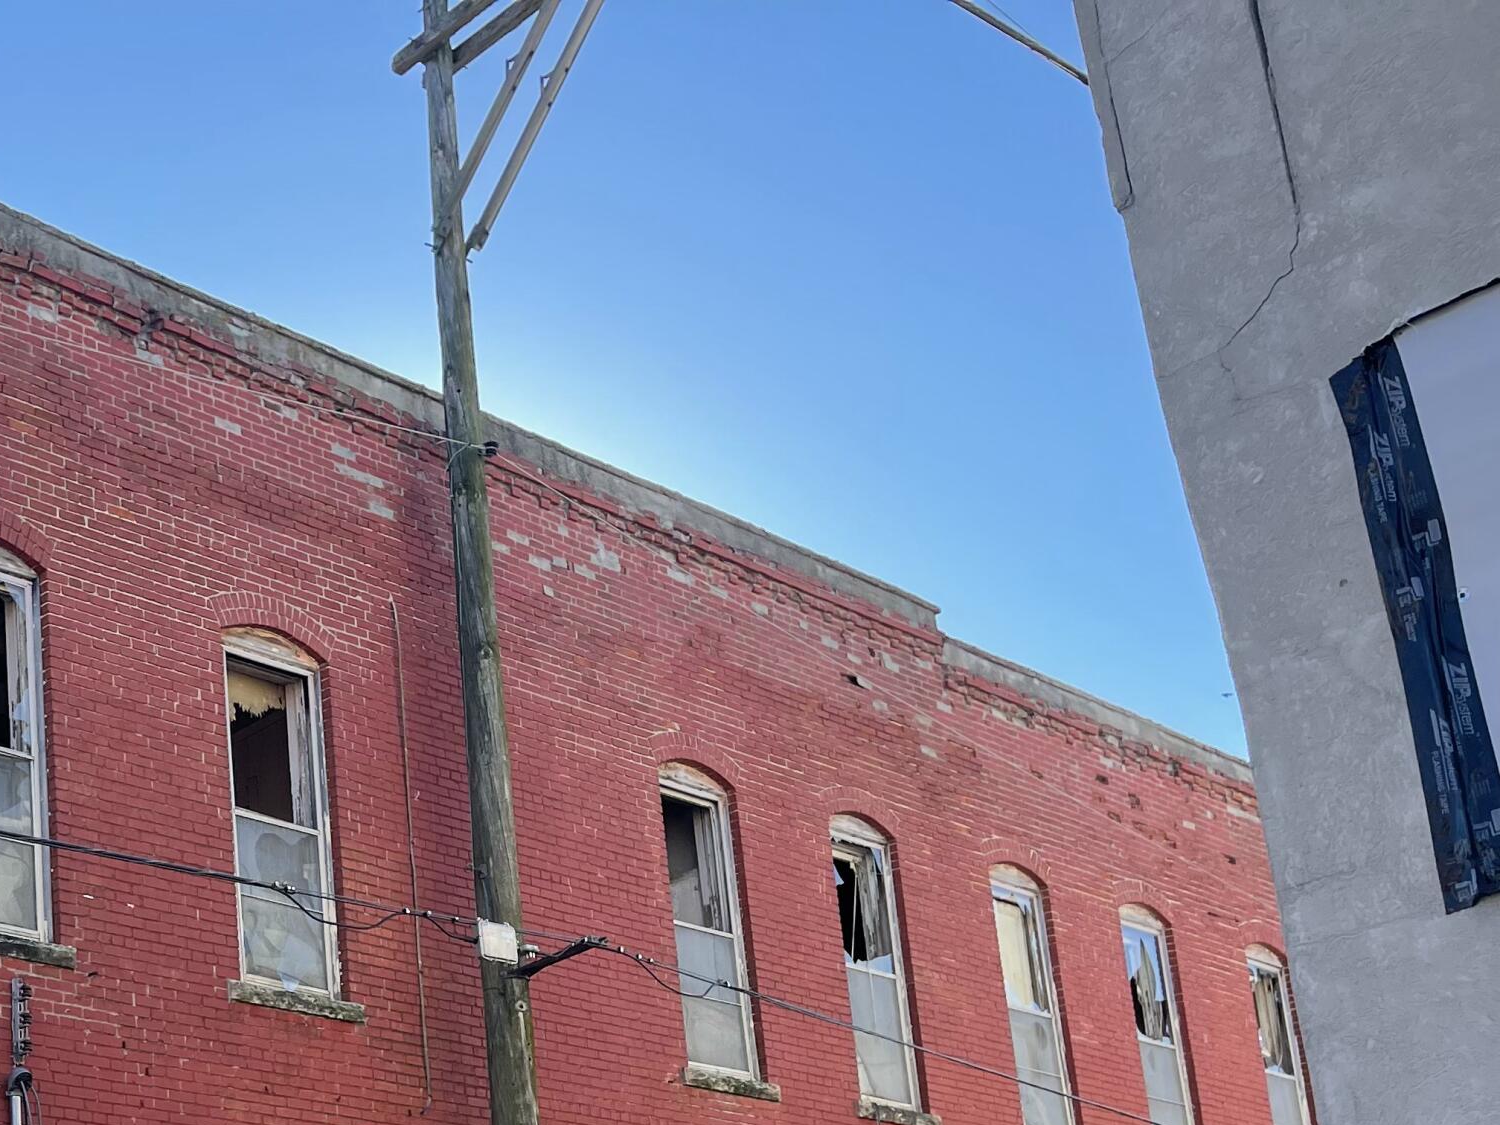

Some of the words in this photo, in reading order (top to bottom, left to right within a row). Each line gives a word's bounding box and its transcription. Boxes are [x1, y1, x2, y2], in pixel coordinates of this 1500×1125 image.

[1383, 376, 1407, 412] ZIP
[1374, 431, 1394, 466] ZIP
[1449, 662, 1472, 698] ZIP
